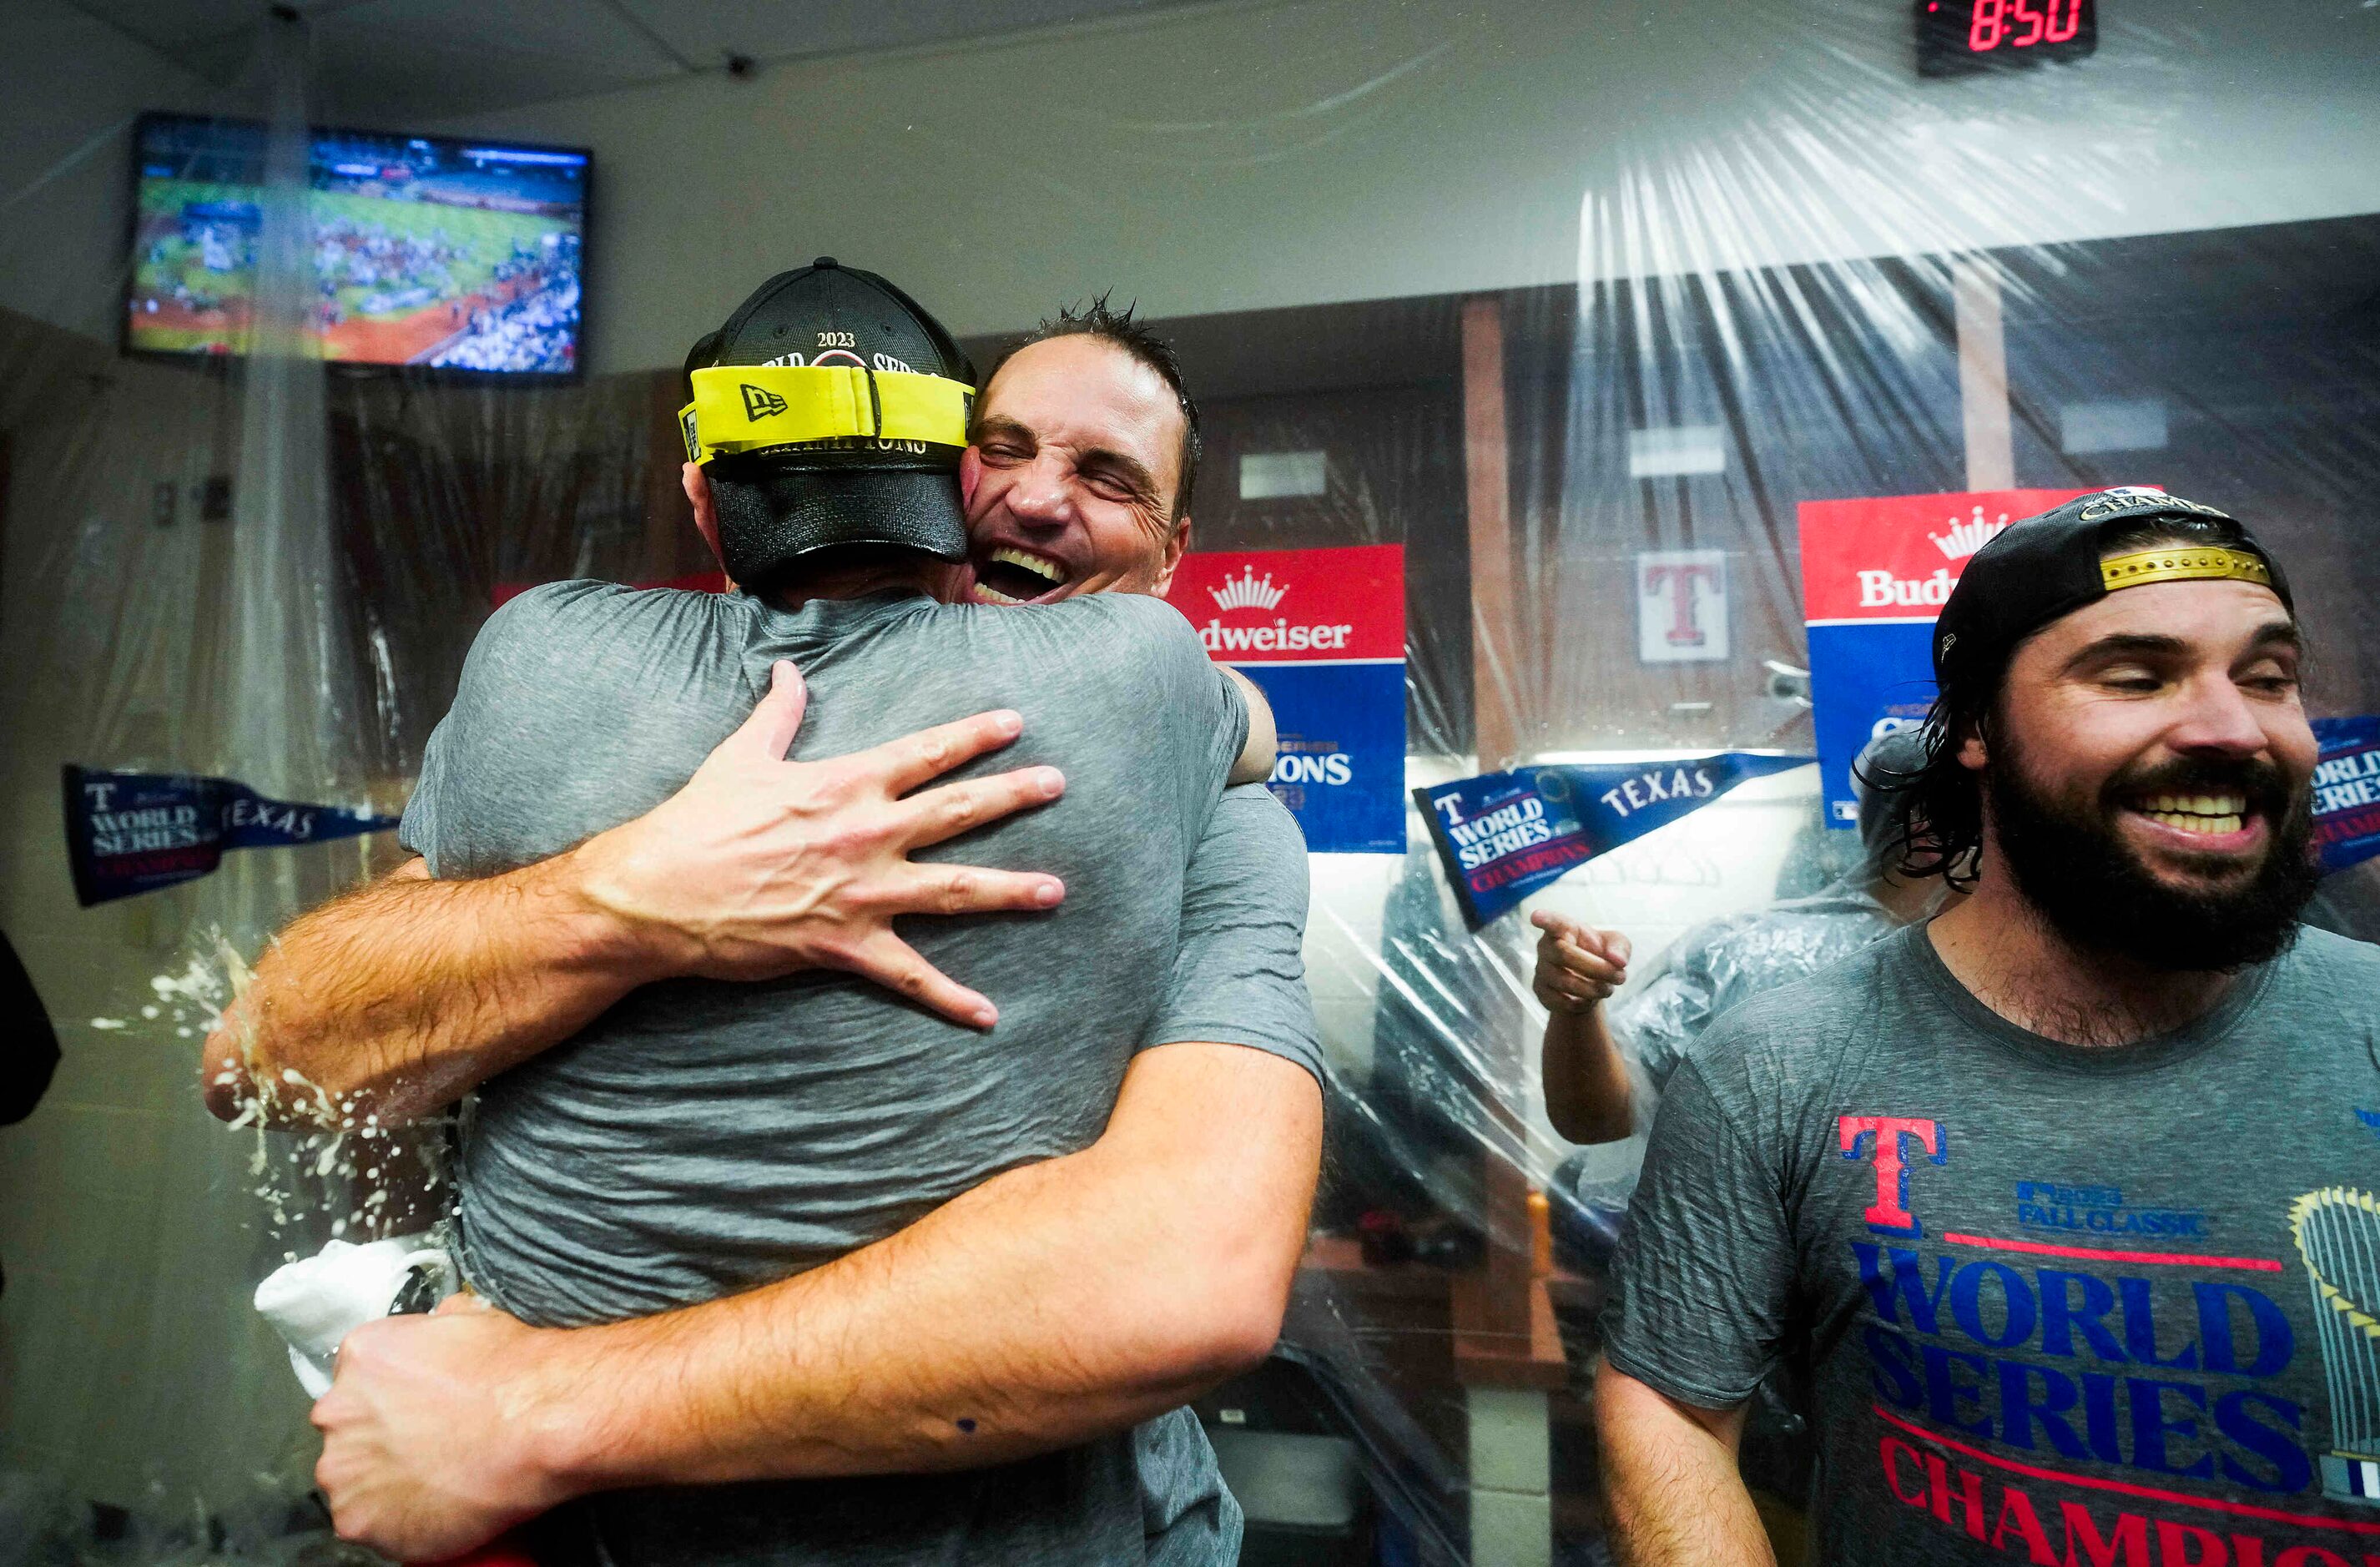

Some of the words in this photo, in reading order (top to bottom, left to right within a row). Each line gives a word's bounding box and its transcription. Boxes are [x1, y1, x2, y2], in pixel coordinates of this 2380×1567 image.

[1969, 0, 2083, 51] 8:50
[817, 332, 856, 347] 2023
[1857, 567, 1961, 607] Bud
[1434, 792, 1465, 825] T
[1600, 767, 1714, 818] TEXAS
[90, 805, 199, 834] WORLD
[1449, 797, 1544, 848] WORLD
[1459, 818, 1552, 870] SERIES
[2017, 1203, 2084, 1231] FALL
[1849, 1241, 2296, 1378] WORLD
[1861, 1323, 2312, 1494] SERIES
